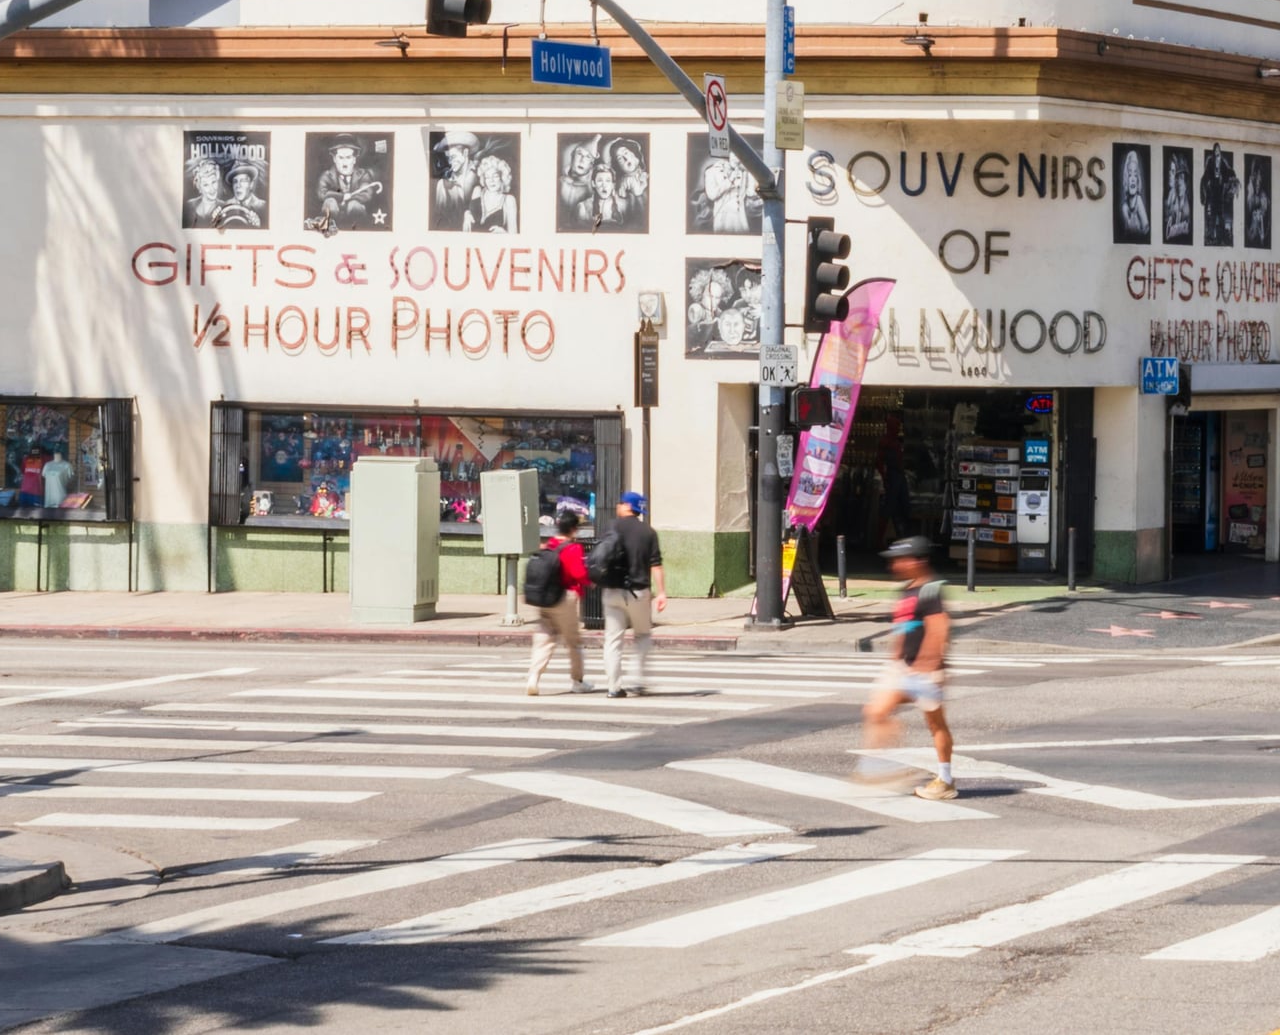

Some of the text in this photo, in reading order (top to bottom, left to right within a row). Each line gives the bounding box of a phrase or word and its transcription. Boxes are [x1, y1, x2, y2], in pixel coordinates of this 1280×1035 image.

[540, 49, 604, 80] Hollywood
[190, 143, 266, 161] HOLLYWOOD
[806, 150, 1107, 202] SOUVENIRS
[131, 241, 627, 294] GIFTS & SOUVENIRS
[939, 229, 1011, 275] OF
[1126, 255, 1194, 302] GIFTS
[242, 304, 373, 353] HOUR
[391, 295, 557, 356] PHOTO
[803, 307, 1108, 356] OLLYWOOD
[1168, 319, 1210, 363] HOUR
[762, 366, 776, 381] OK
[1144, 360, 1177, 378] ATM
